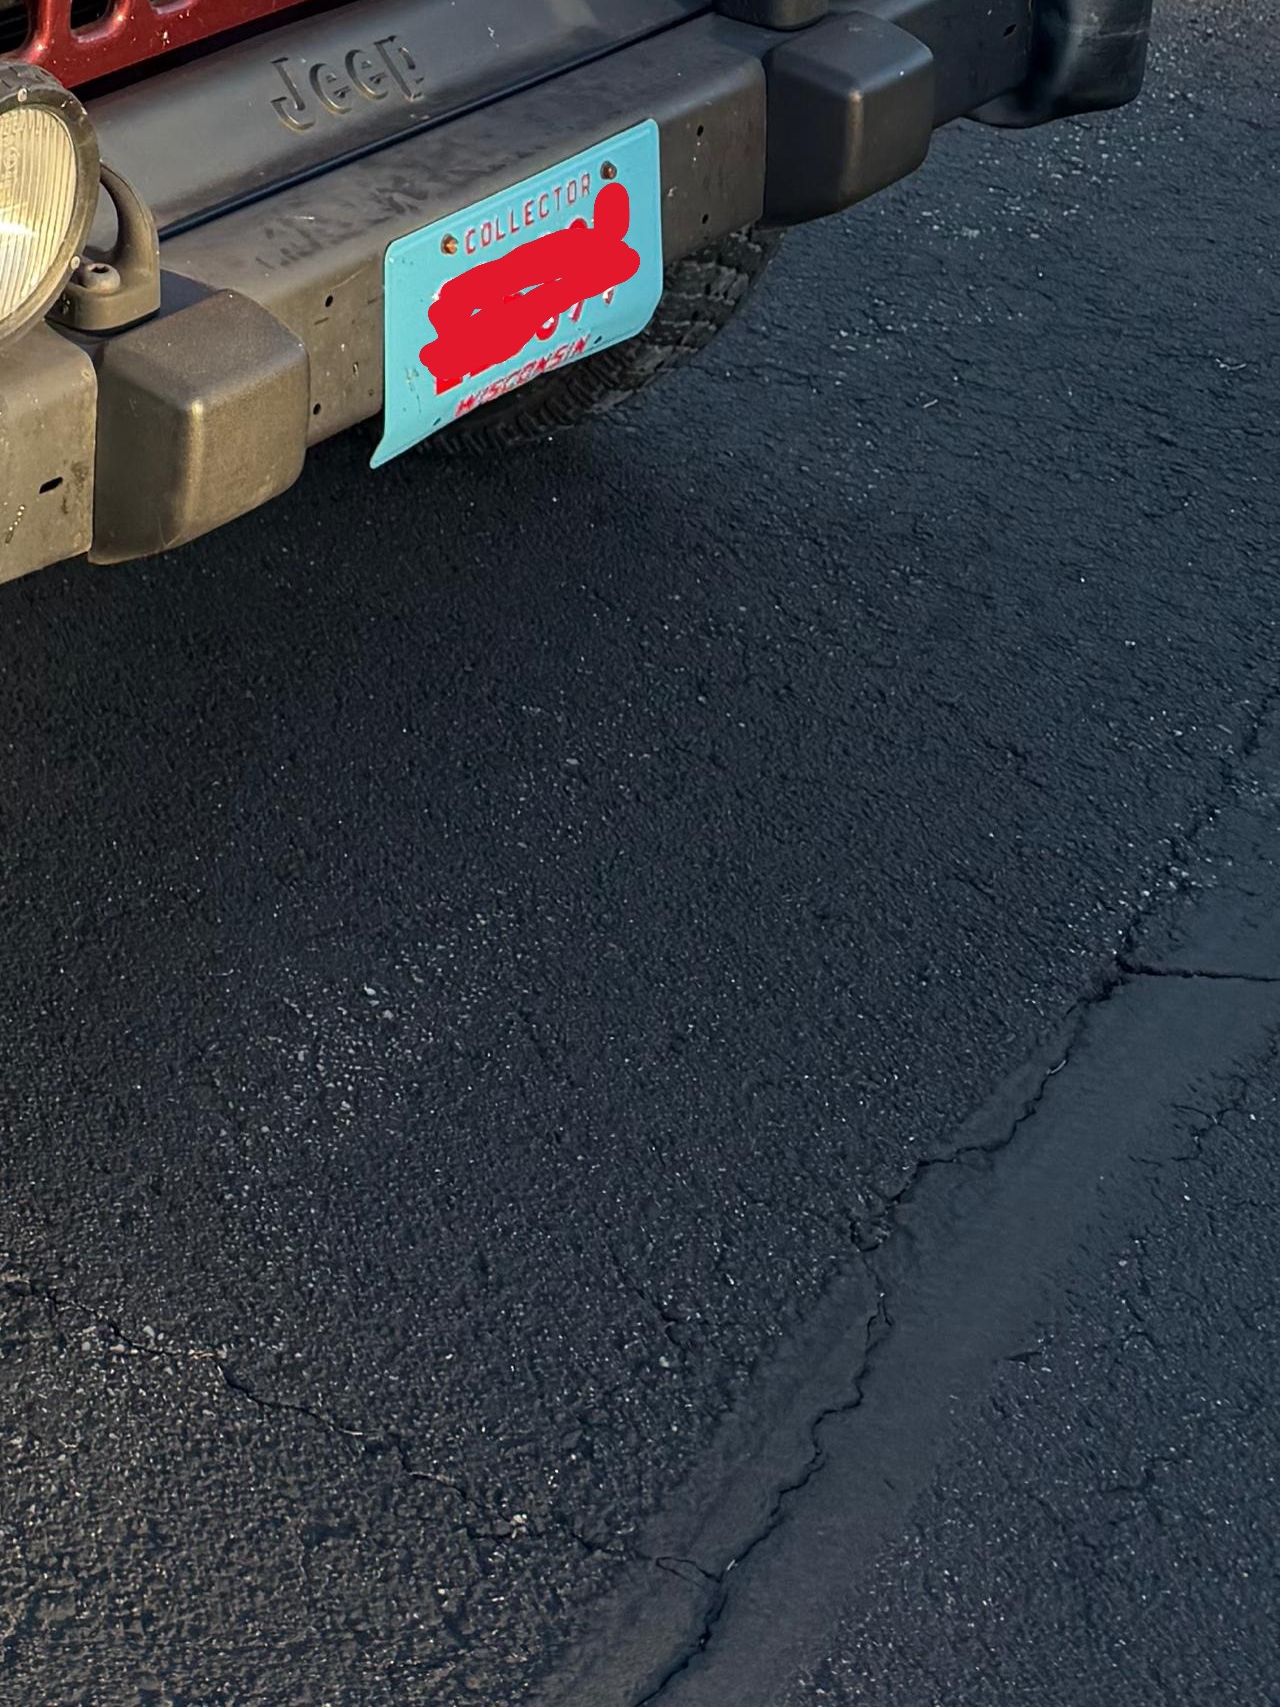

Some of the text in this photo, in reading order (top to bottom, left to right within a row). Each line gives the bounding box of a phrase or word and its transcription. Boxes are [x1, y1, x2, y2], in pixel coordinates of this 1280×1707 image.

[270, 34, 427, 132] Jeep
[464, 172, 591, 255] COLLECTOR
[454, 333, 591, 418] WISCONSIN
